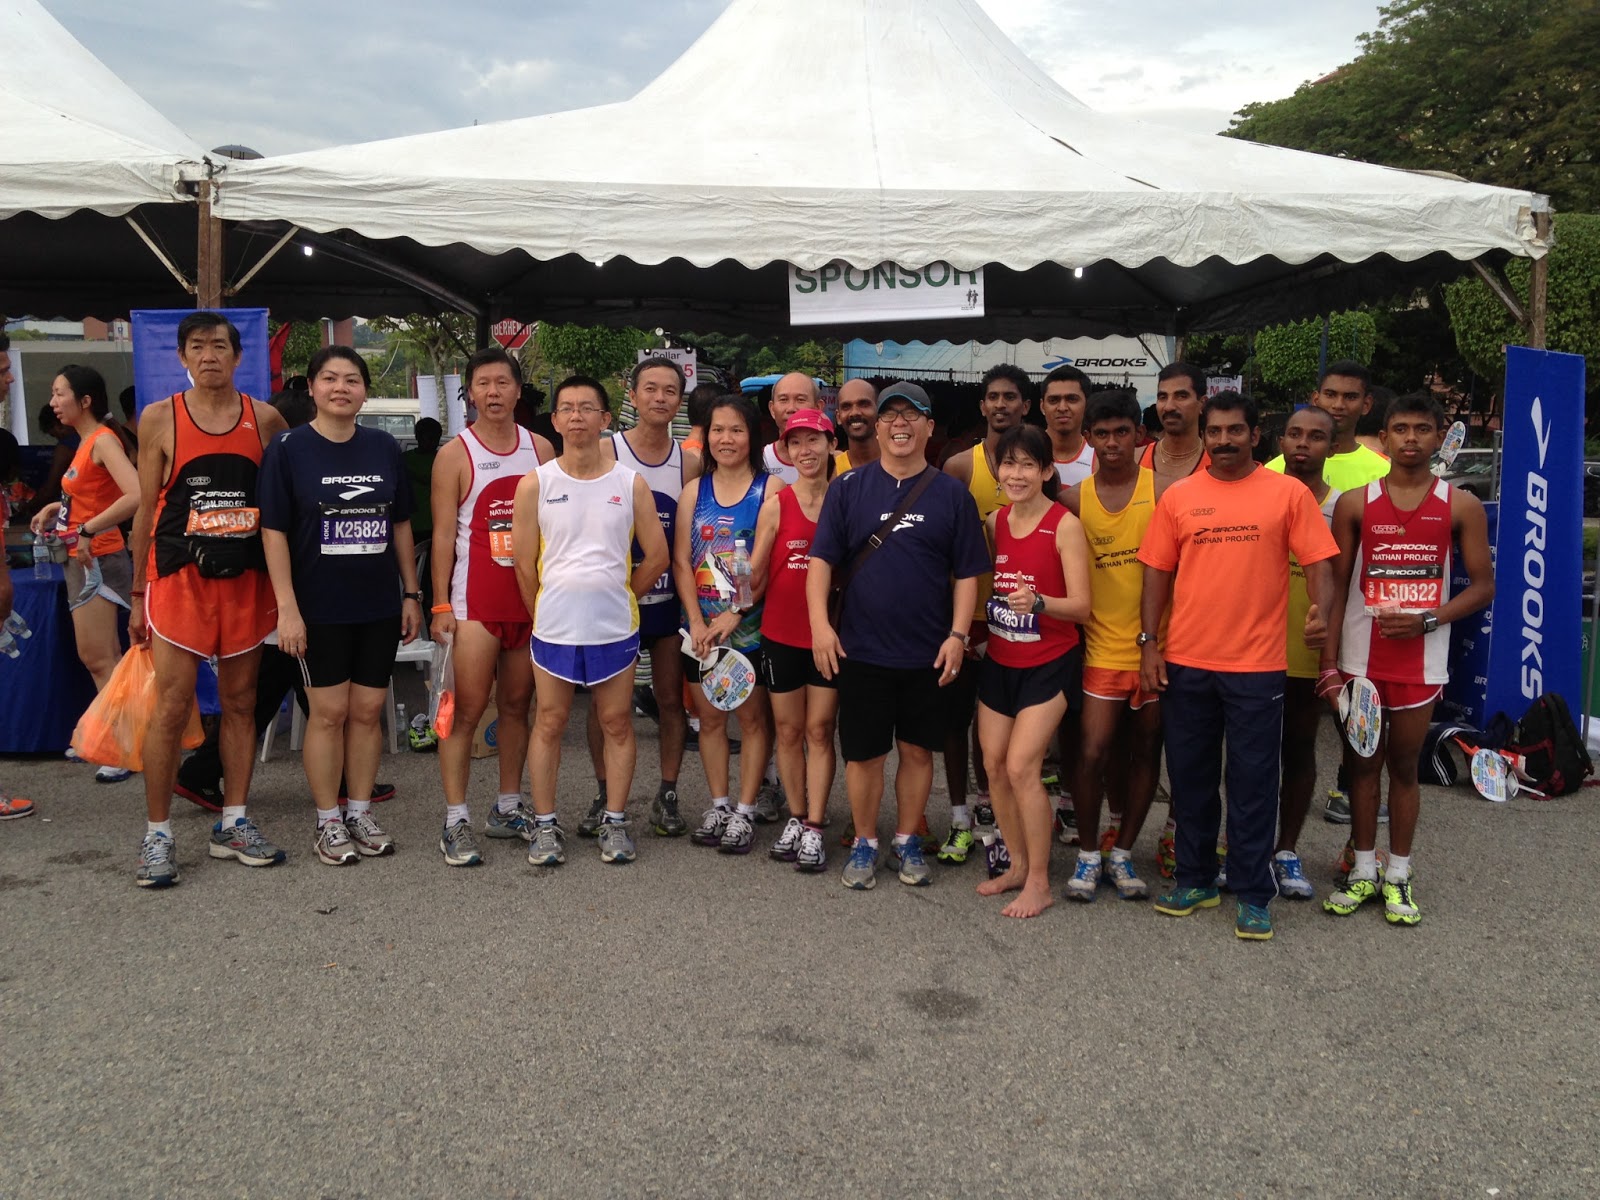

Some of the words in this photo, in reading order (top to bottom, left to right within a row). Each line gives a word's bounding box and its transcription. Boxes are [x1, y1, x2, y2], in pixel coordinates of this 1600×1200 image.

[652, 351, 681, 360] Collar
[1074, 357, 1148, 368] BROOKS
[321, 474, 384, 485] BROOKS
[340, 507, 377, 515] BROOKS
[334, 520, 387, 539] K25824
[1212, 524, 1260, 533] BROOKS
[1193, 536, 1223, 545] NATHAN
[1225, 534, 1261, 543] PROJECT
[1390, 543, 1439, 552] BROOKS
[1372, 553, 1402, 561] NATHAN
[1404, 553, 1439, 562] PROJECT
[1095, 560, 1122, 570] NATHAN
[1385, 568, 1428, 576] BROOKS
[1521, 471, 1549, 700] BROOKS
[1379, 582, 1439, 602] L30322
